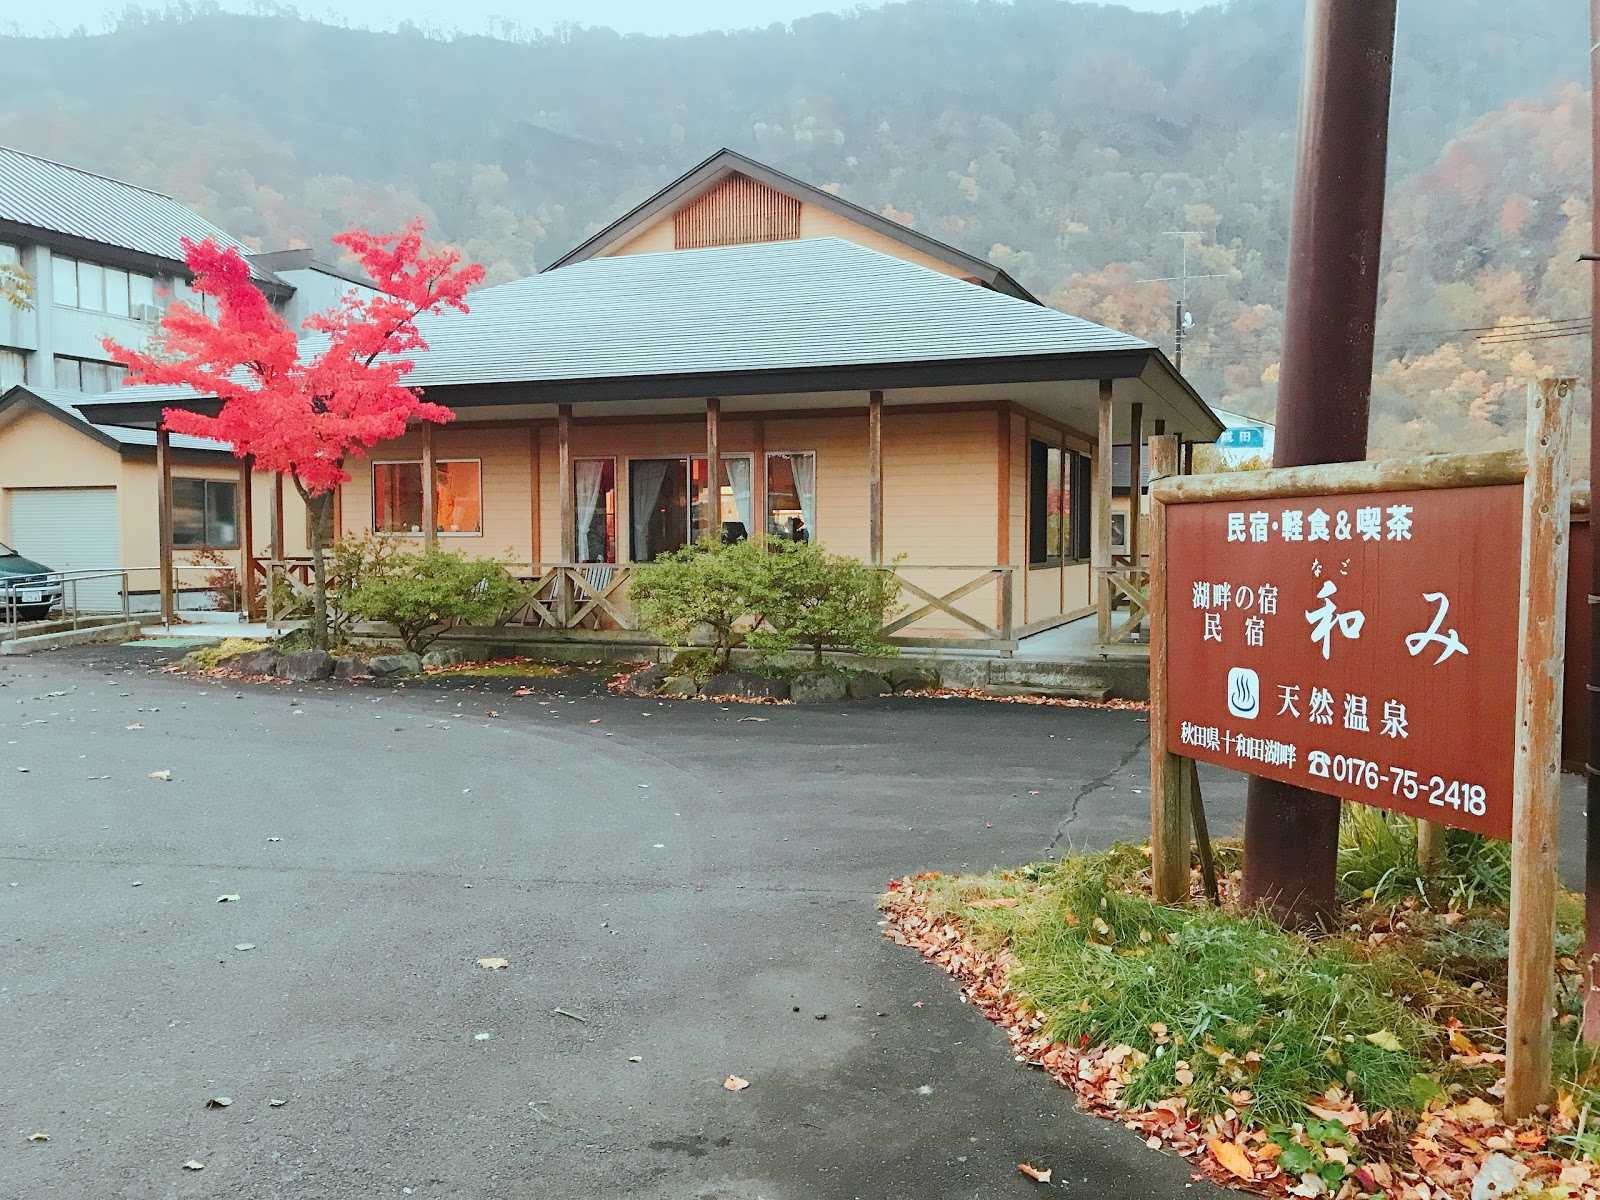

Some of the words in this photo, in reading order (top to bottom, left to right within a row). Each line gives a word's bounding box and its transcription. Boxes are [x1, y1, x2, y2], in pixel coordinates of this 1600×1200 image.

[1192, 581, 1279, 616] 湖畔の宿
[1203, 613, 1266, 647] 民宿
[1276, 684, 1409, 740] 天然温泉
[1180, 720, 1297, 769] 秋田県十和田湖畔
[1333, 757, 1487, 816] 0176-75-2418
